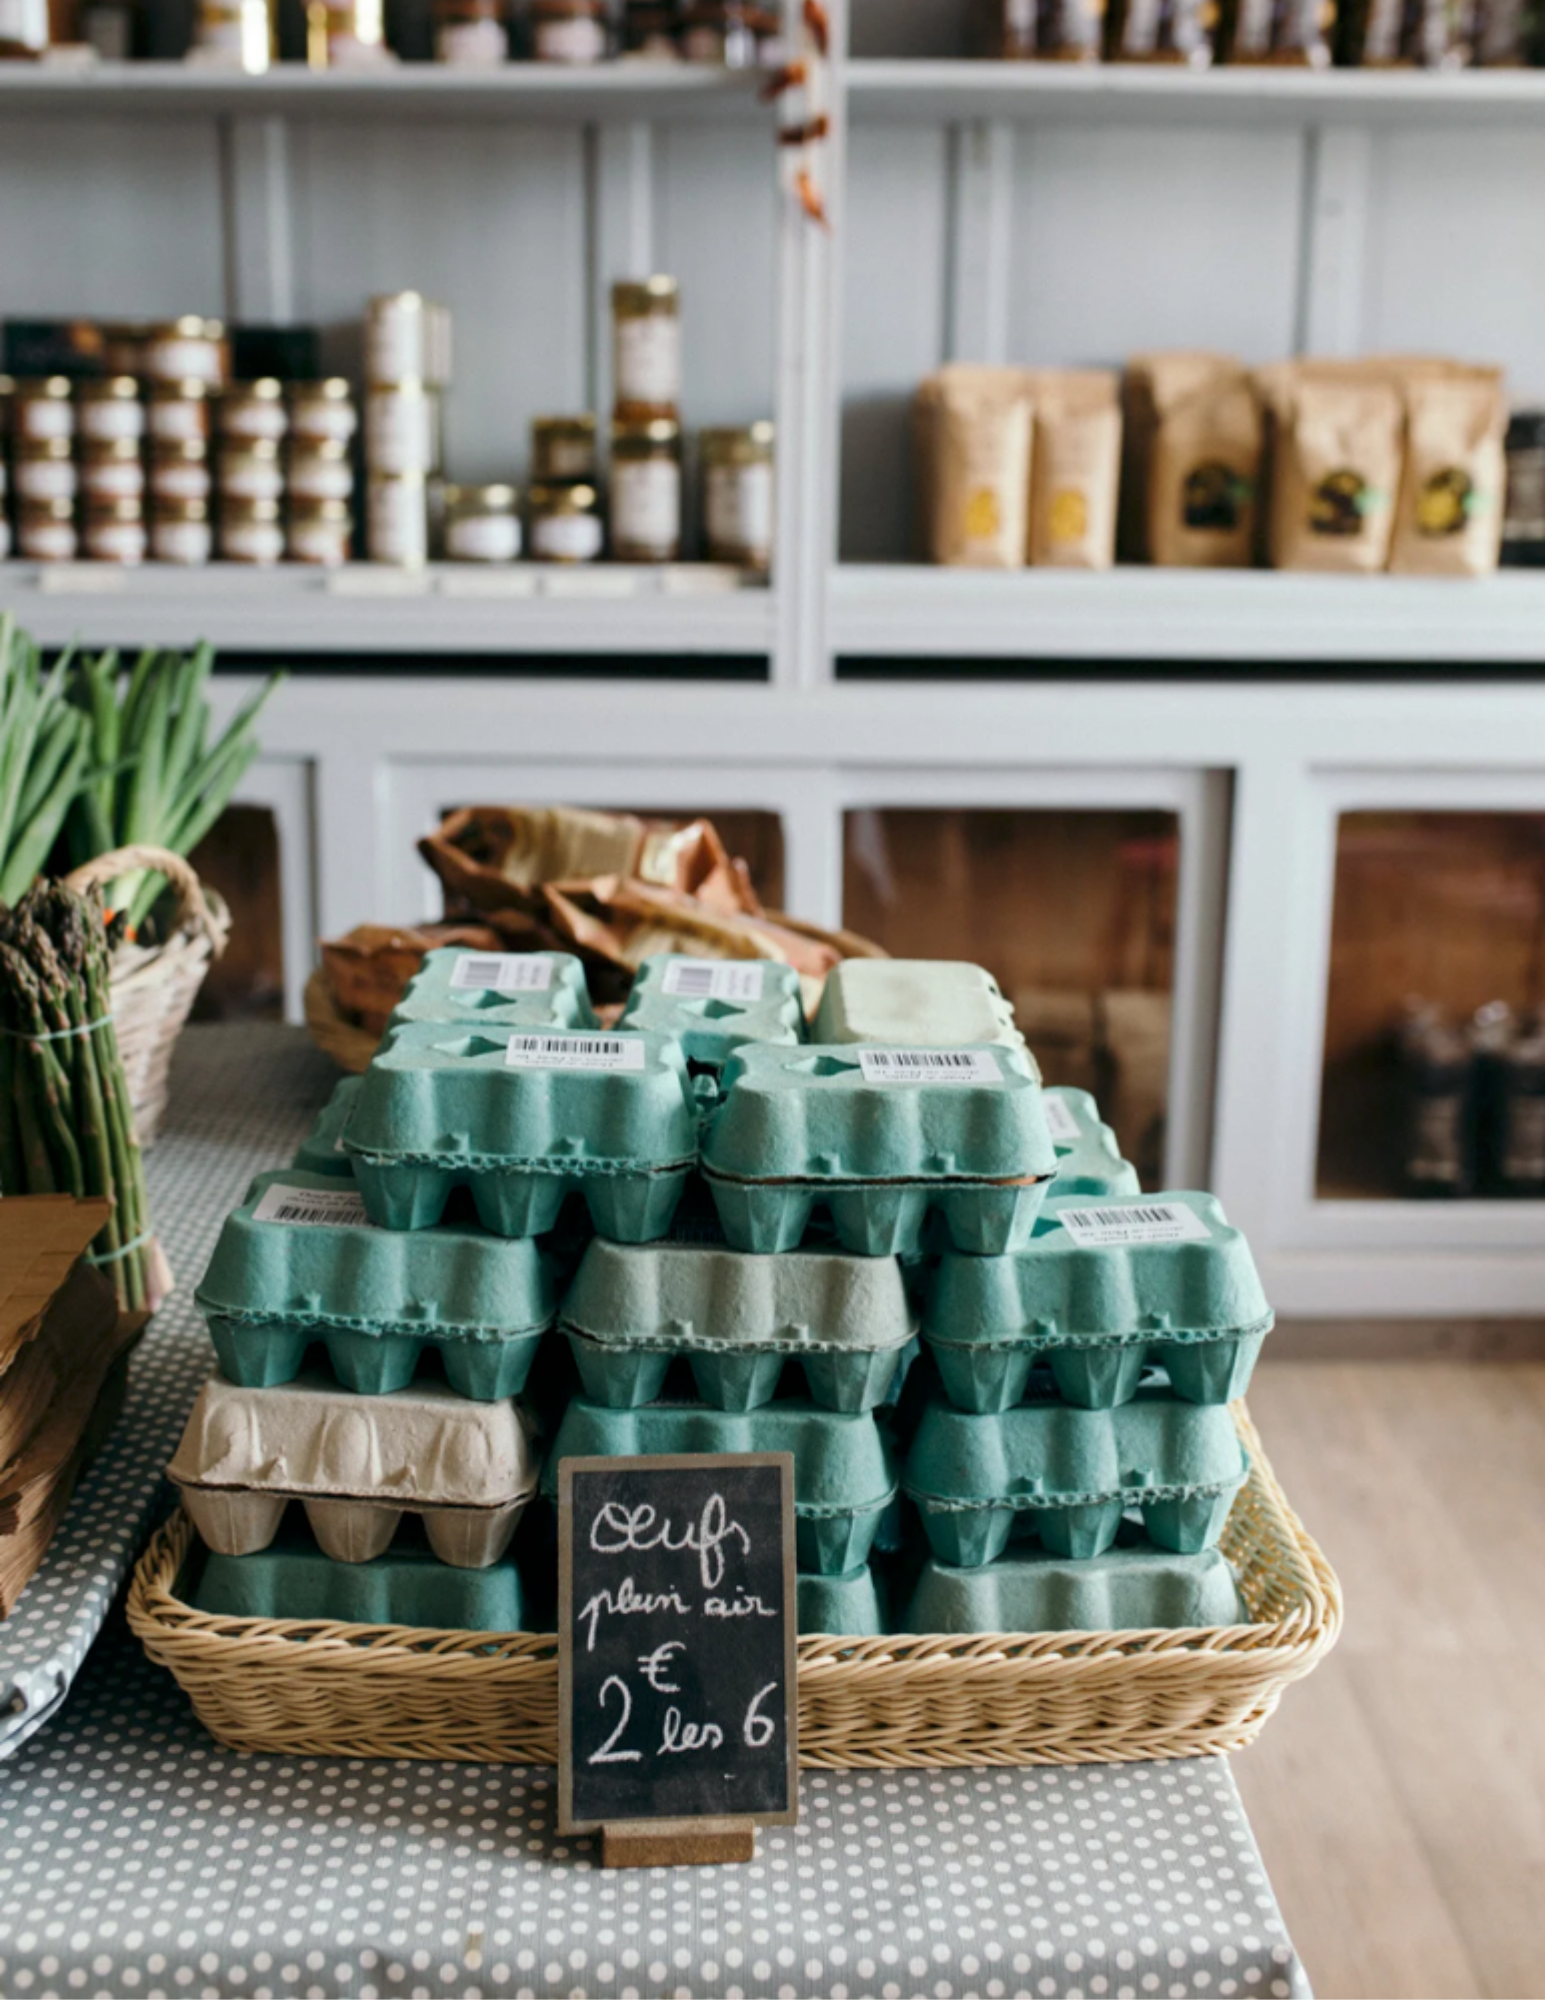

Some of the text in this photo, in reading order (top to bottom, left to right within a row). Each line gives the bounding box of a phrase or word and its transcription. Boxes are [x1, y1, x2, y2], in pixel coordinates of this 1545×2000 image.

[578, 1577, 778, 1652] plein air
[637, 1640, 687, 1693] €
[587, 1675, 778, 1765] 2 les 6
